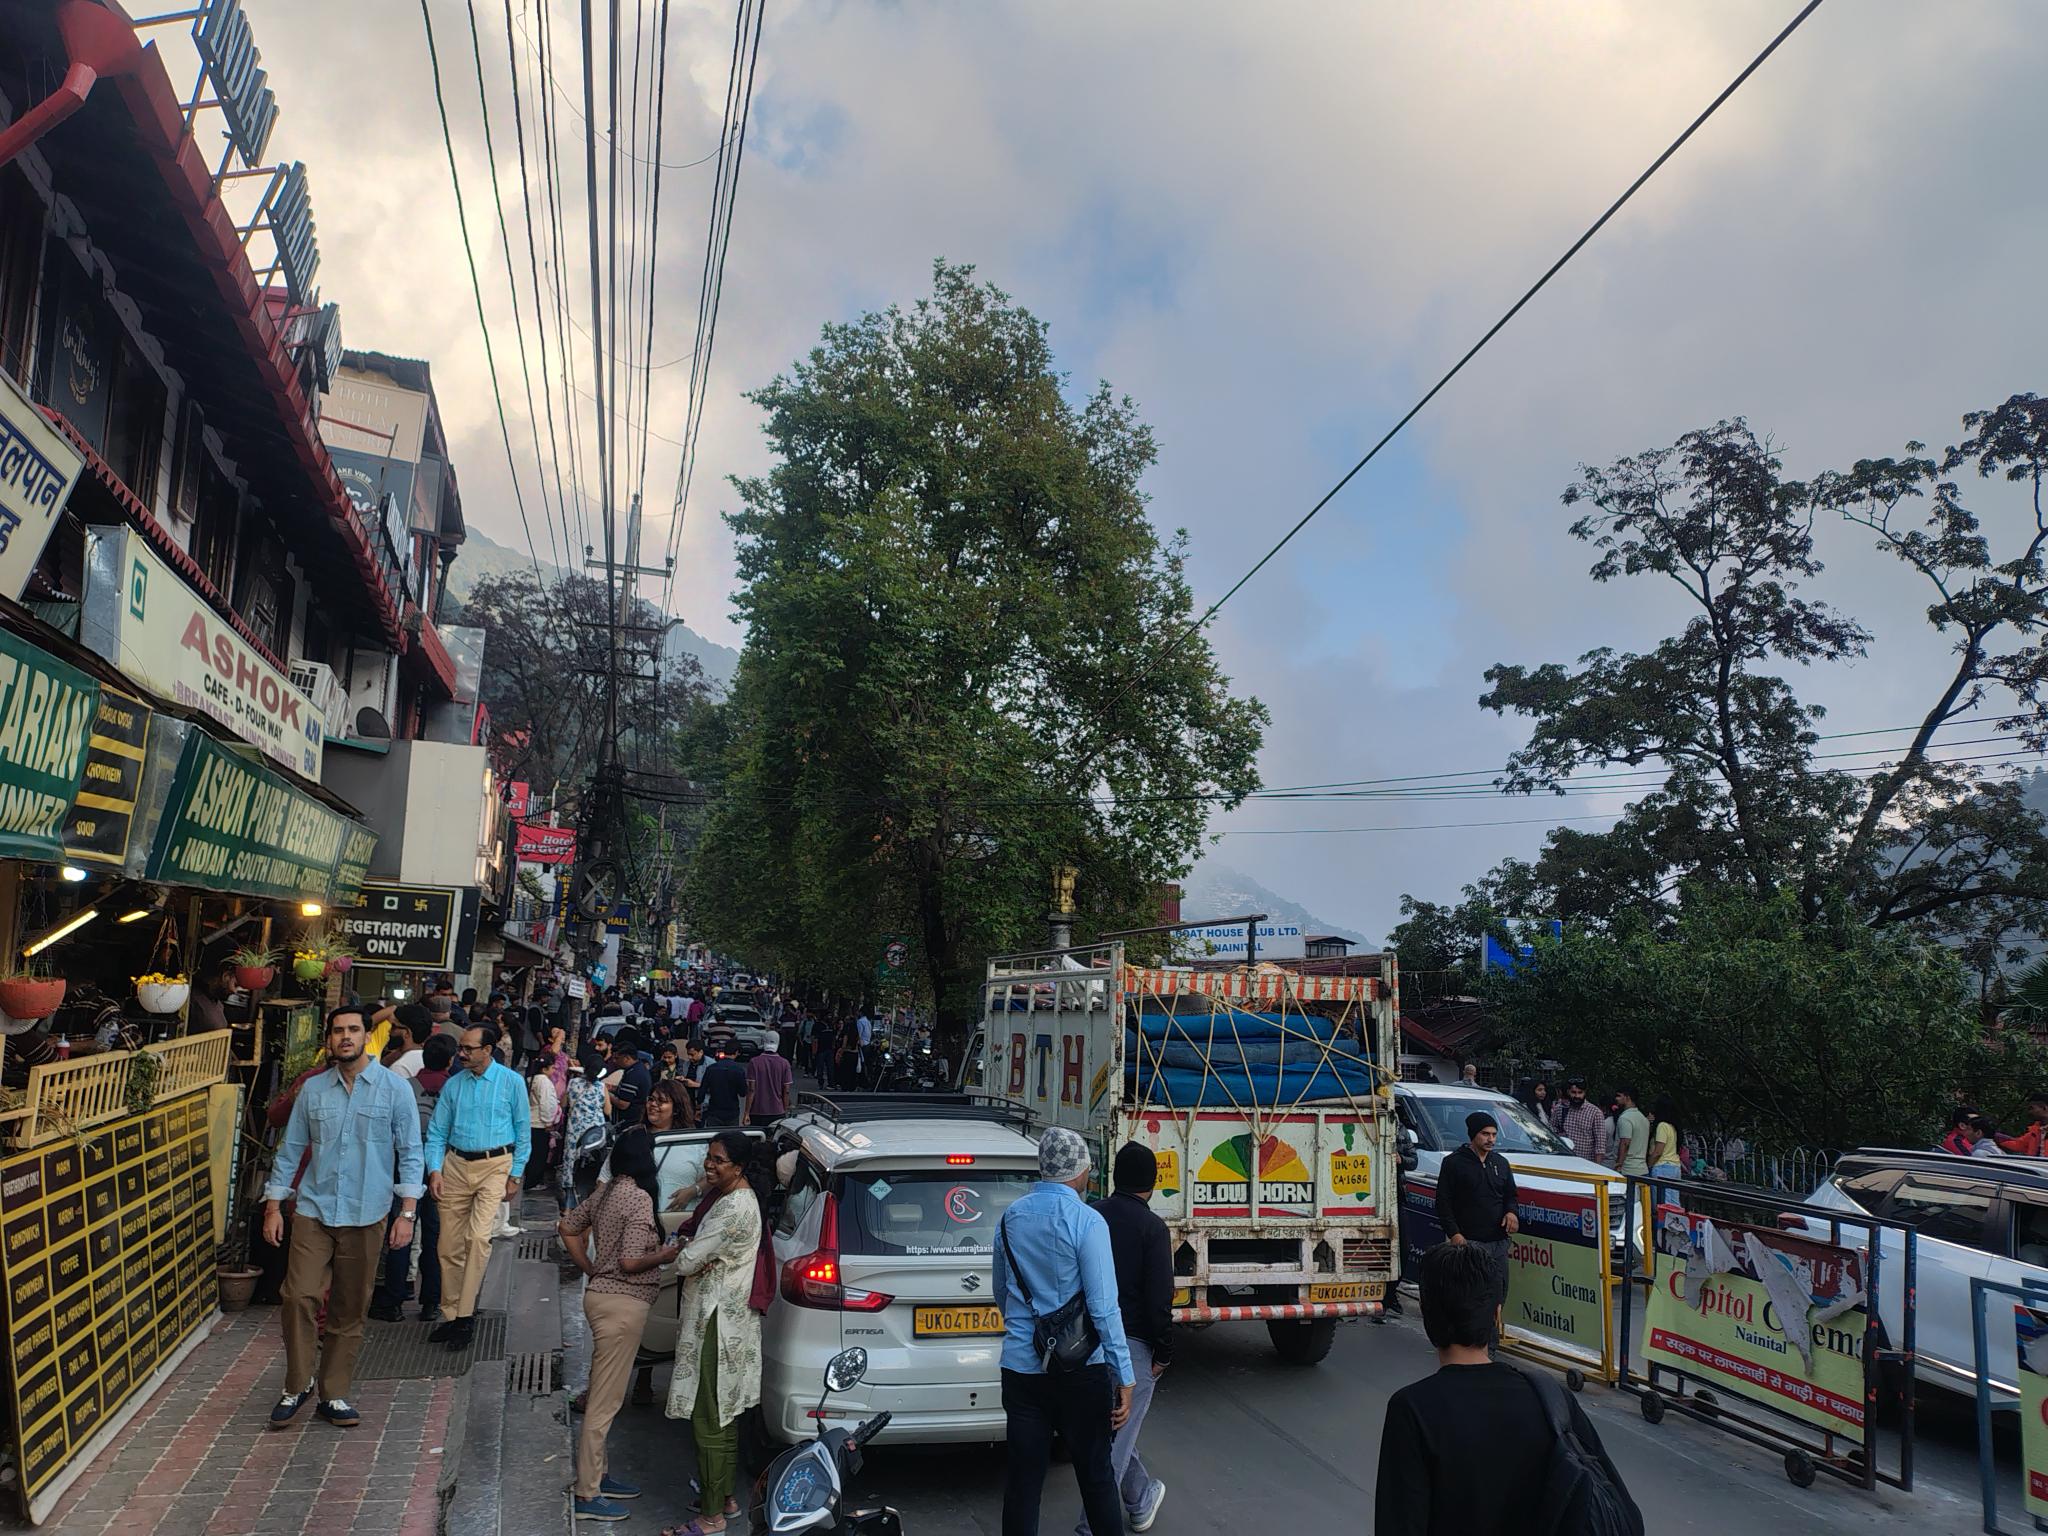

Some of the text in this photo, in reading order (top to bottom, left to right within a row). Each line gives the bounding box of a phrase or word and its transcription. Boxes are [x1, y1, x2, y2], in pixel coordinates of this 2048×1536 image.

[180, 610, 301, 733] ASHOK
[204, 673, 229, 706] CAFE
[246, 704, 267, 733] FOUR
[267, 722, 284, 741] WAY
[185, 752, 257, 840] ASHOK
[251, 781, 290, 847] PURE
[281, 796, 346, 866] VEGETARIAN
[76, 820, 96, 838] SOUP
[179, 837, 231, 877] INDIAN
[232, 851, 271, 883] SOUTH
[268, 856, 301, 888] INDIAN
[334, 918, 443, 940] VEGETARIAN'S
[1206, 928, 1244, 938] HOUSE
[1247, 927, 1275, 937] LUB
[1278, 926, 1301, 937] LTD.
[366, 939, 407, 956] ONLY
[873, 1185, 889, 1193] CNG
[1194, 1182, 1313, 1203] BLOW HORN
[10, 1223, 41, 1250] SANDWICH
[60, 1254, 80, 1275] COFFEE
[1507, 1241, 1555, 1269] apitol
[1317, 1283, 1383, 1299] UK04CA1686
[1551, 1275, 1596, 1305] Cinema
[1522, 1301, 1575, 1334] Nainital
[1669, 1271, 1754, 1323] Cpitol
[1763, 1300, 1865, 1360] Cema
[1735, 1324, 1787, 1355] Nainital
[1697, 1348, 1713, 1363] पर
[1714, 1355, 1768, 1384] लापरवाही
[1769, 1372, 1782, 1389] से
